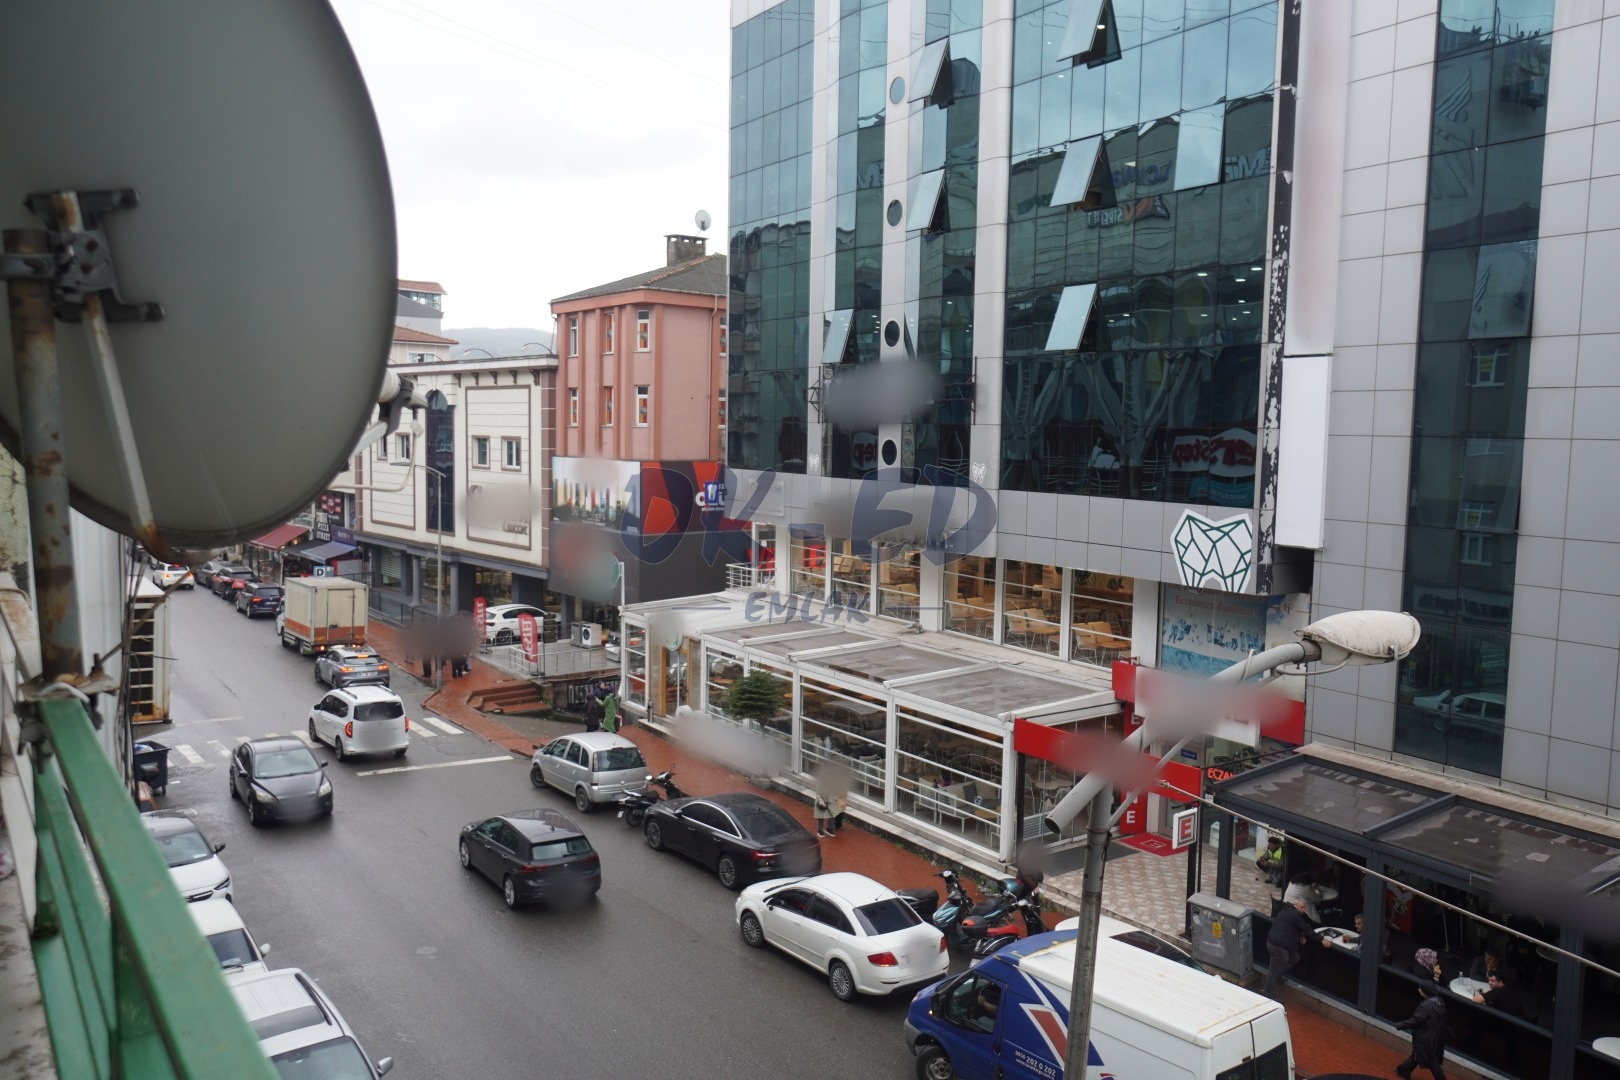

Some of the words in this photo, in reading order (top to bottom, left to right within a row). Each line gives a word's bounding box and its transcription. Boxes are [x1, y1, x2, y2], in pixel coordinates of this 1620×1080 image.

[317, 522, 330, 532] PIZZA
[316, 530, 331, 541] STREET
[316, 568, 325, 577] D
[1180, 817, 1193, 840] E
